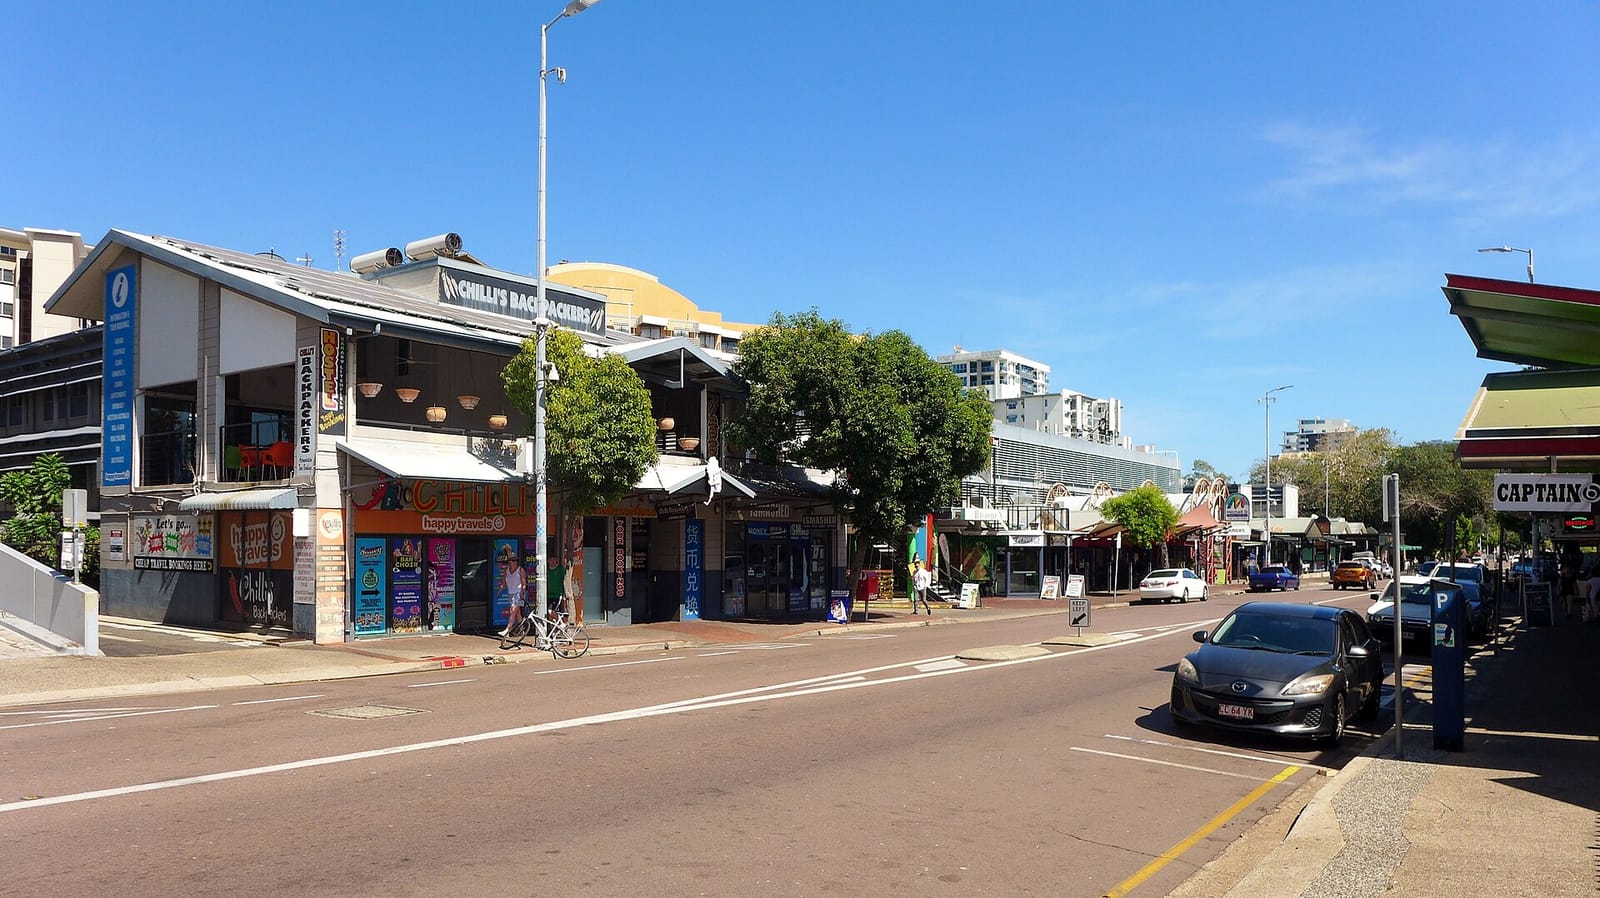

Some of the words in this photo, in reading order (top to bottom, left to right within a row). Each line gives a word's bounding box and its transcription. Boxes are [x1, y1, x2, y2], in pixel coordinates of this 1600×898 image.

[459, 279, 507, 306] CHILLI'S
[510, 291, 591, 323] BACPACKERS
[322, 330, 338, 409] HOSTEL
[300, 357, 312, 454] BACKPACKERS
[1497, 484, 1582, 503] CAPTAIN
[156, 519, 174, 529] Let's
[615, 520, 625, 546] TOUR
[135, 558, 150, 568] CHEAP
[150, 559, 168, 569] TRAVEL
[168, 560, 192, 571] BOOKINGS
[193, 561, 207, 571] HERE
[236, 544, 280, 561] taves
[615, 548, 625, 598] BOOKINGS
[685, 525, 699, 616] 货币兑换
